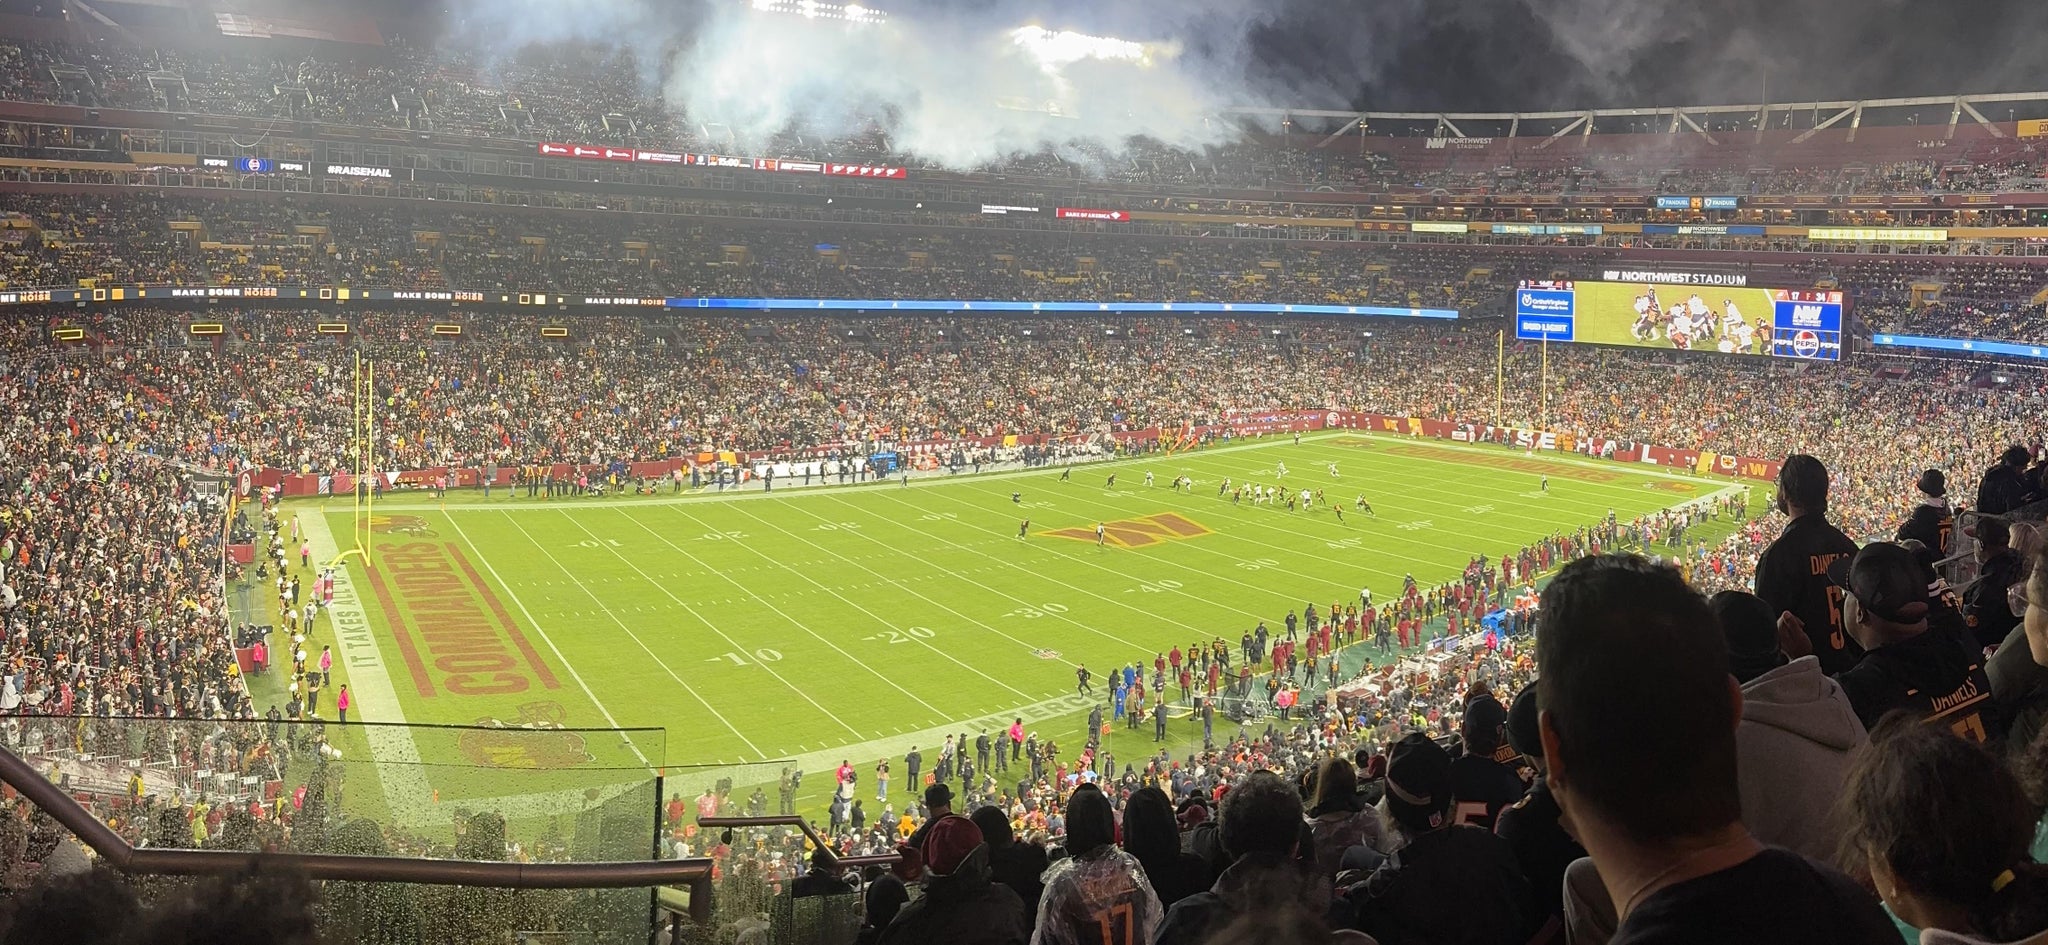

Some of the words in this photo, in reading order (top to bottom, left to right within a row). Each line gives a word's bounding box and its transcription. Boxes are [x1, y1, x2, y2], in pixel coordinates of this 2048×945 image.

[204, 159, 228, 167] PEPSI
[280, 163, 303, 171] PEPSI
[328, 165, 391, 178] #RAISEHAIL
[1621, 271, 1691, 283] NORTHWEST
[1692, 273, 1746, 285] STADIUM
[20, 292, 51, 302] NOISE
[172, 289, 205, 297] MAKE
[208, 288, 240, 297] SOME
[244, 288, 277, 297] NOISE
[425, 292, 451, 300] SOME
[454, 292, 483, 301] NOISE
[1791, 291, 1800, 300] 17
[1815, 292, 1826, 301] 34
[1792, 305, 1822, 320] NW
[1523, 322, 1541, 331] BUD
[1542, 323, 1568, 332] LIGHT
[1236, 558, 1281, 571] 50
[1139, 579, 1185, 594] 40
[1014, 602, 1070, 620] 30
[1826, 585, 1845, 650] 5
[375, 541, 530, 696] COMMANDERS
[336, 610, 372, 650] TAKES
[877, 626, 936, 645] 20
[350, 655, 379, 668] IT
[722, 648, 783, 667] 10
[1931, 676, 1978, 713] DANIELS
[1092, 902, 1134, 945] 17
